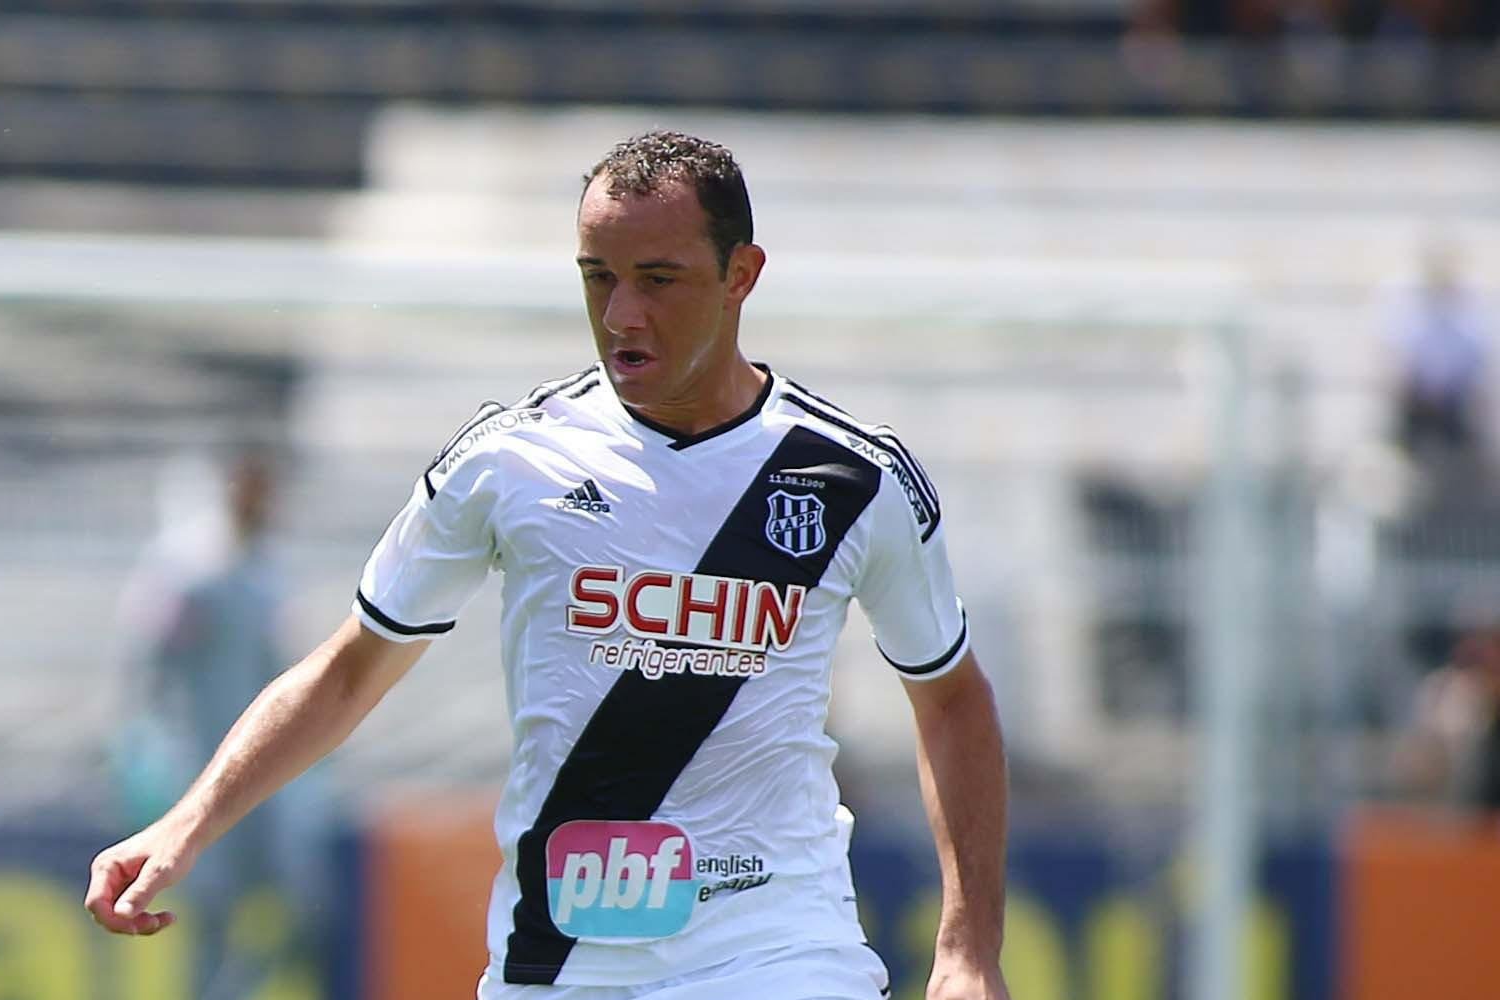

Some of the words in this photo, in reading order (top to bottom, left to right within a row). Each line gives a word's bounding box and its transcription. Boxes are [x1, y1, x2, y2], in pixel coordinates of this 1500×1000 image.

[448, 411, 529, 470] MONROE
[857, 444, 924, 515] MONROE
[556, 498, 611, 514] adidas
[772, 512, 817, 533] AAPP
[567, 565, 805, 651] SCHIN
[589, 638, 766, 681] refrigerantes
[556, 836, 687, 924] pbf
[696, 854, 764, 877] english
